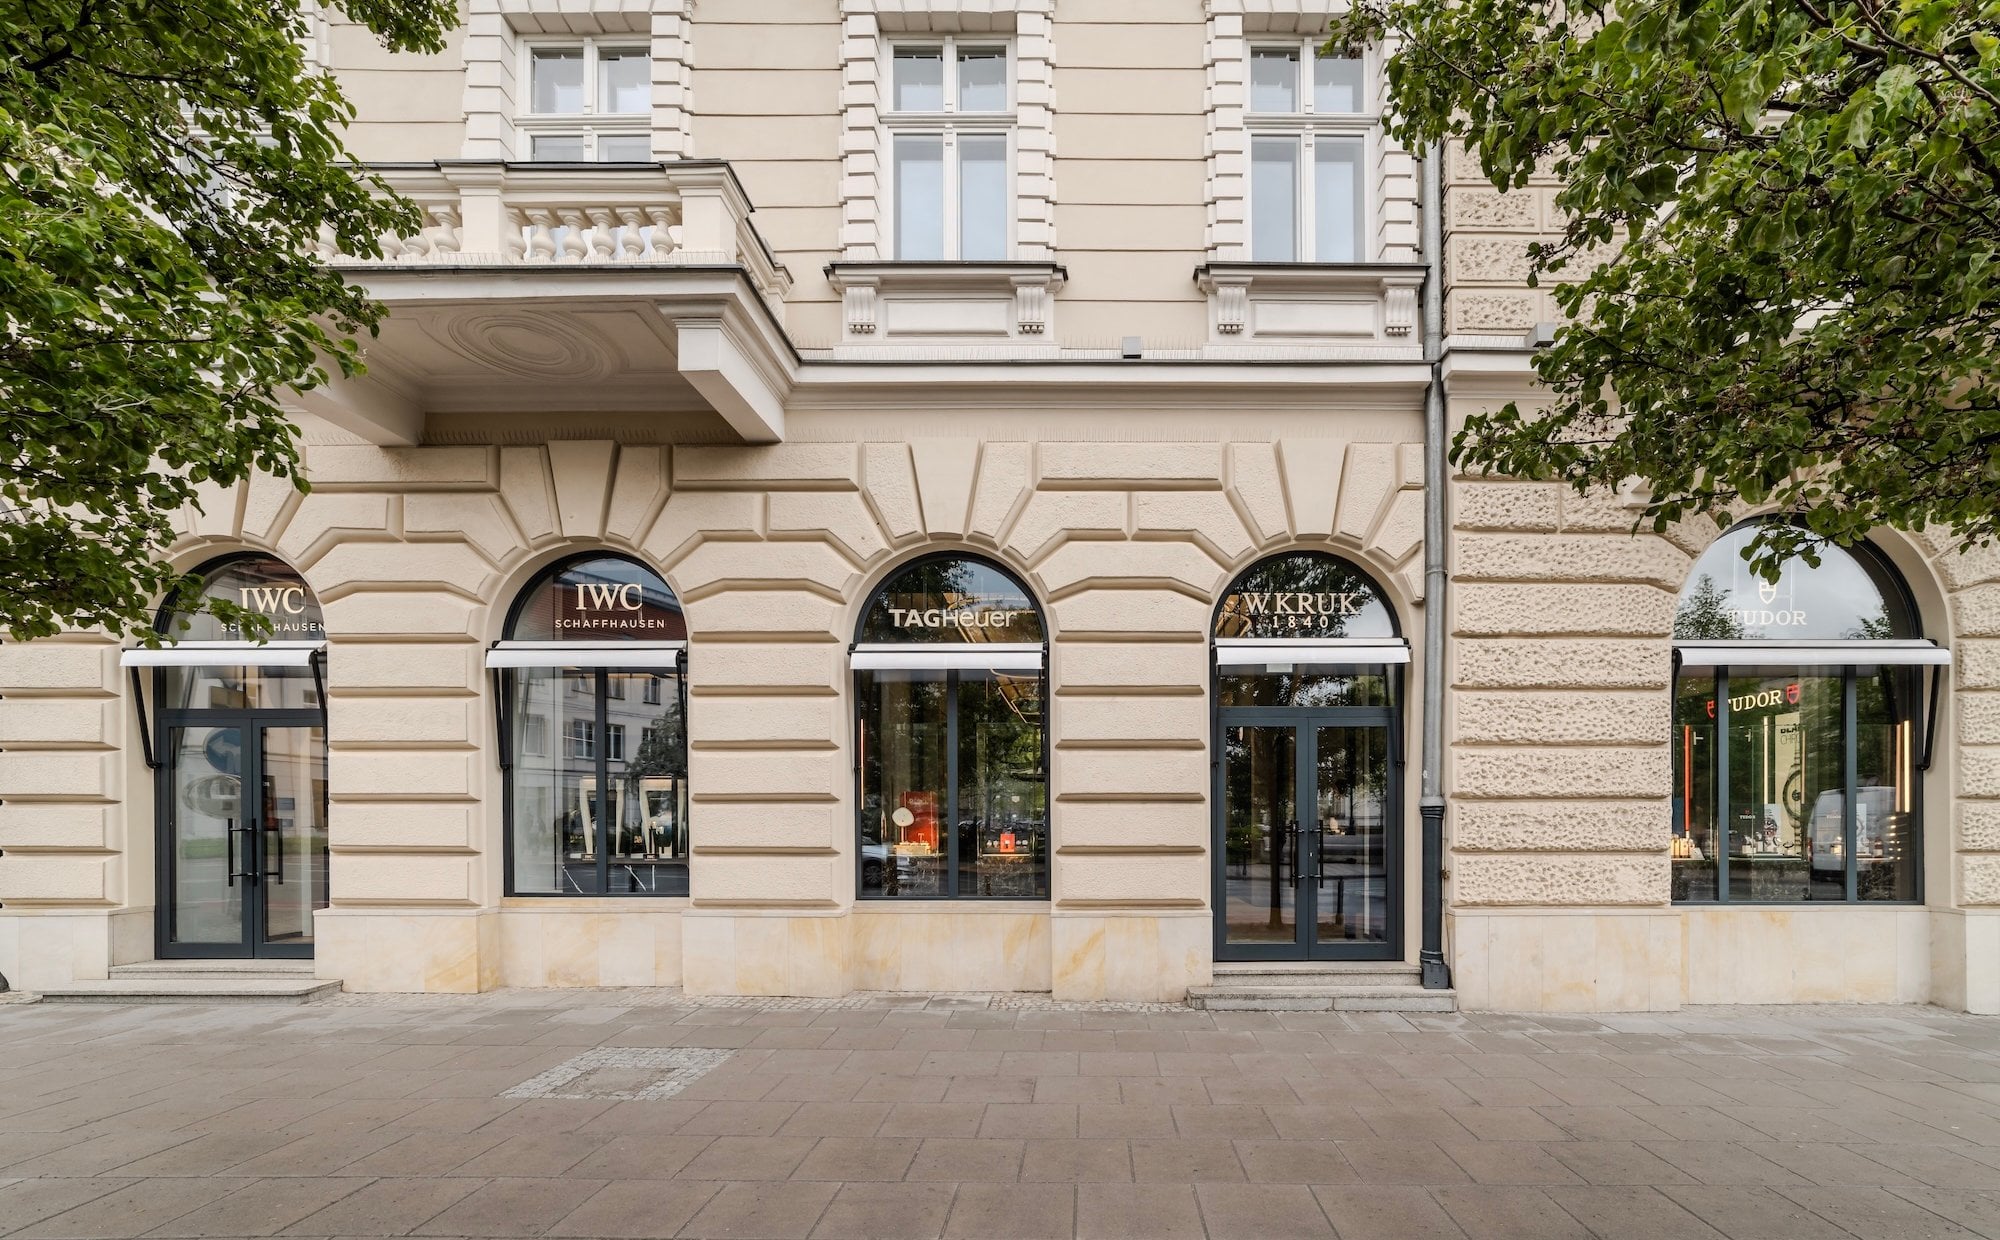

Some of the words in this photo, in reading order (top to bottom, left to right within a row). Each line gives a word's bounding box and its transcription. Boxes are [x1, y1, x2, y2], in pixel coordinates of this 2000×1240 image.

[240, 587, 305, 614] IWC
[575, 583, 643, 611] IWC
[555, 619, 665, 628] SCHAFFHAUSEN
[1272, 615, 1329, 628] 1840
[1727, 610, 1807, 626] TUDOR
[1728, 689, 1782, 712] UDOR
